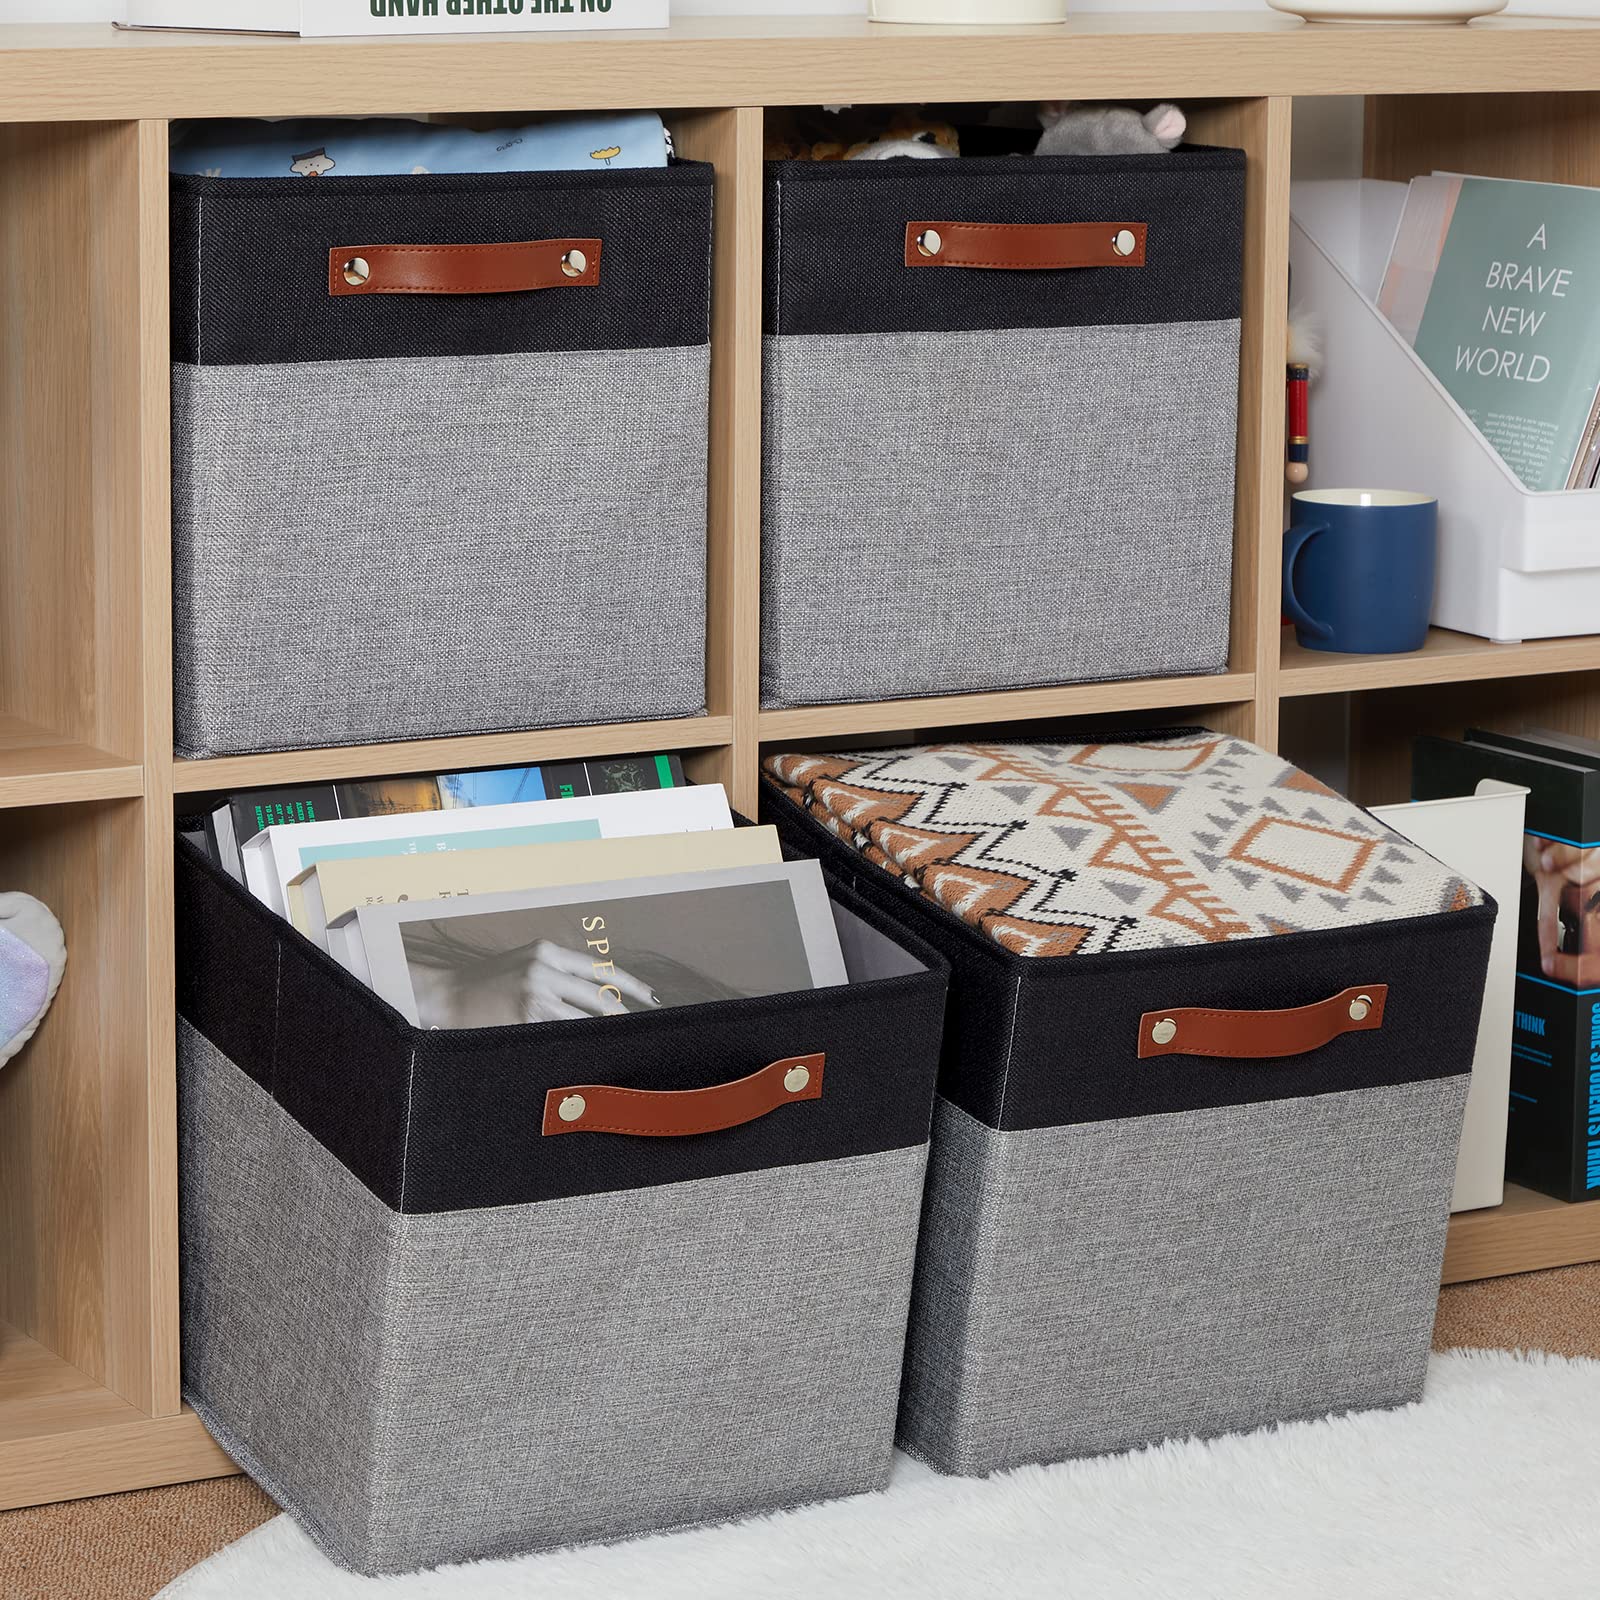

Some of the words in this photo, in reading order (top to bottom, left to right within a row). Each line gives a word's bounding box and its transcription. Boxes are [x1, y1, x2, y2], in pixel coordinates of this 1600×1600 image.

[369, 0, 439, 17] HAND
[445, 0, 524, 16] OTHER
[530, 0, 575, 14] THE
[1526, 223, 1547, 250] A
[1485, 261, 1573, 297] BRAVE
[1482, 305, 1546, 337] NEW
[1455, 345, 1551, 383] WORLD
[1515, 1011, 1546, 1036] THINK
